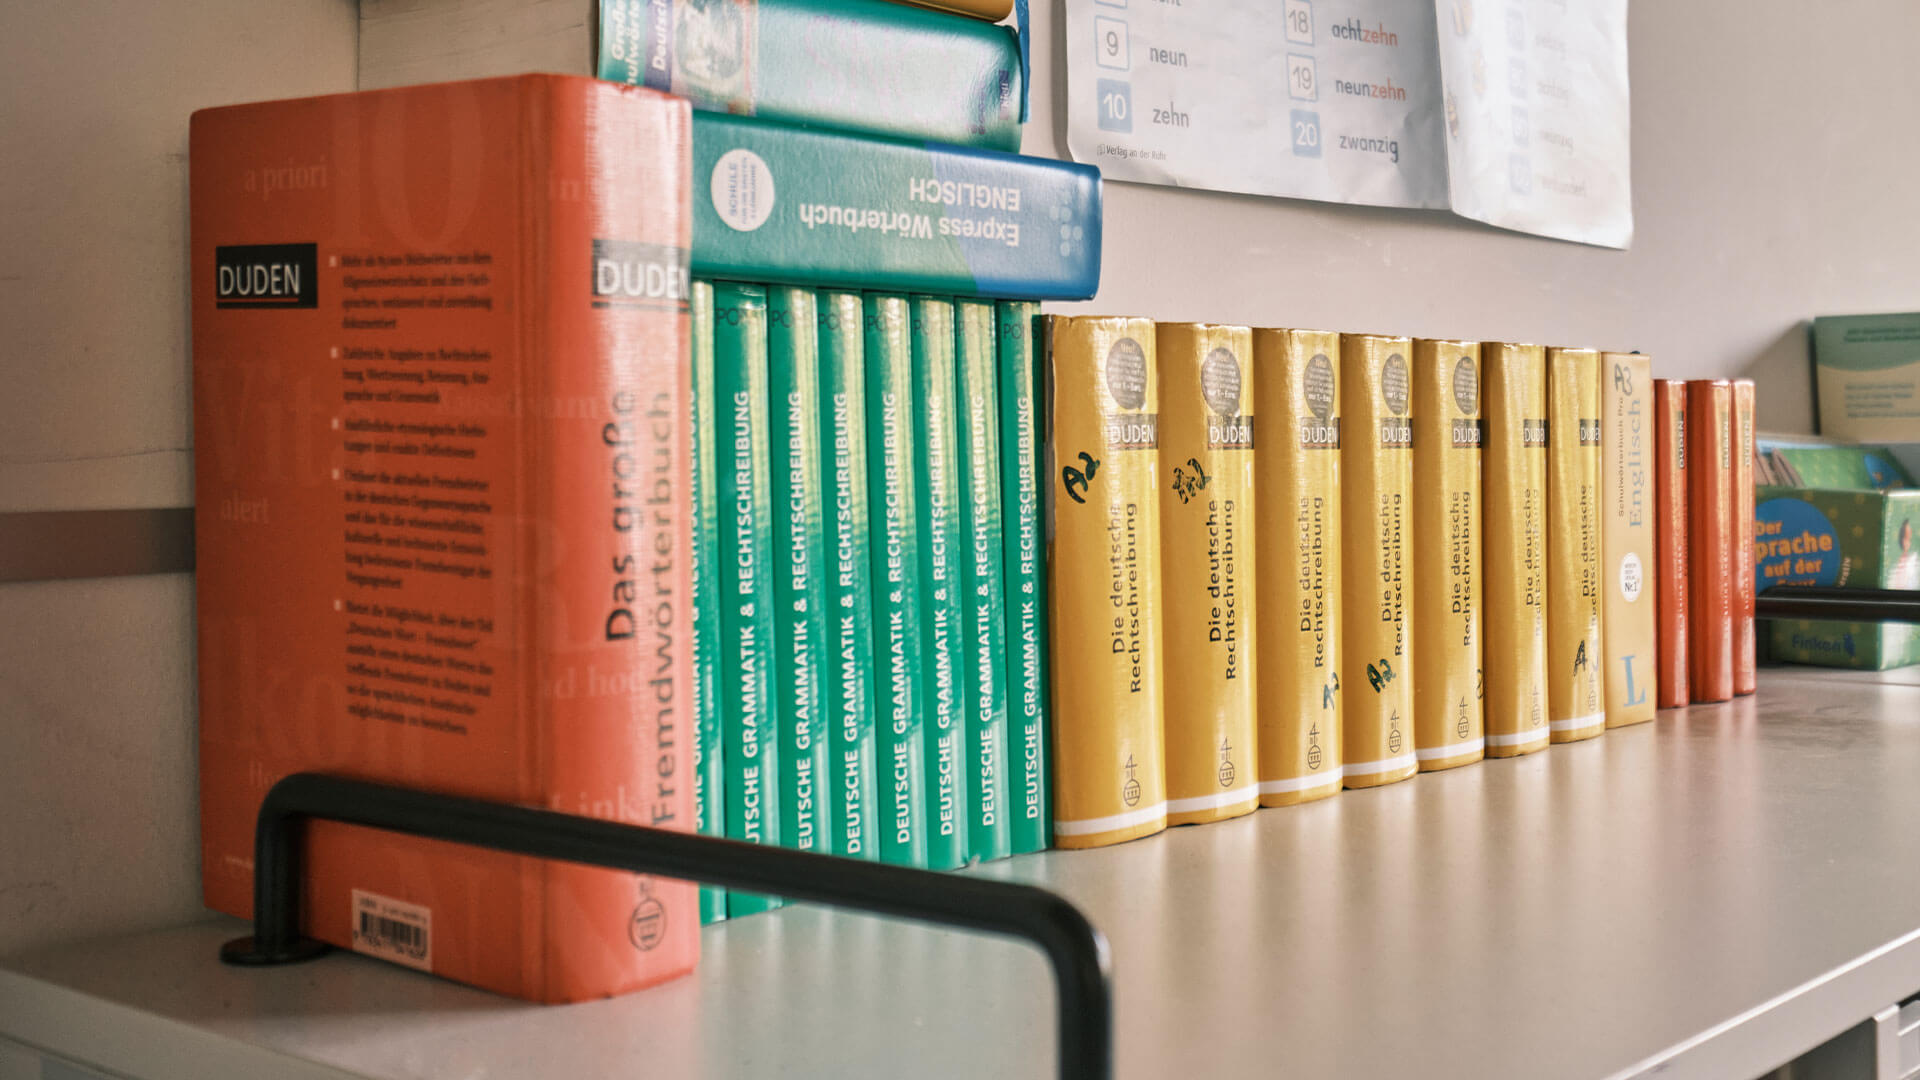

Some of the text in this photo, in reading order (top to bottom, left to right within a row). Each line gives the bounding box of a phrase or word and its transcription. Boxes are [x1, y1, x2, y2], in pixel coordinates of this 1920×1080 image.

[1106, 31, 1119, 57] 9
[1288, 8, 1309, 34] 18
[1331, 20, 1398, 47] achtzehn
[1150, 47, 1188, 67] neun
[1292, 65, 1312, 90] 19
[1103, 92, 1127, 120] 10
[1335, 76, 1406, 102] neunzehn
[1152, 101, 1190, 128] zehn
[1295, 122, 1318, 147] 20
[1339, 131, 1399, 162] zwanzig
[908, 177, 1020, 212] ENGLISCH
[800, 203, 1020, 247] Express Wörterbuch
[219, 262, 301, 296] DUDEN
[595, 261, 690, 300] DUDEN
[1614, 362, 1633, 397] A3
[1110, 425, 1154, 443] DUDEN
[1209, 425, 1250, 443] DUDEN
[1301, 426, 1337, 444] DUDEN
[1382, 426, 1412, 443] DUDEN
[1453, 427, 1480, 443] DUDEN
[1524, 427, 1545, 442] DUDE
[1677, 420, 1685, 469] DUDEN
[1062, 451, 1100, 503] A2
[1628, 399, 1644, 528] Englisch
[603, 391, 643, 642] Das große
[1755, 520, 1783, 537] Der
[1298, 495, 1311, 632] Die deutsche
[1380, 494, 1393, 622] Die deutsche
[1450, 491, 1462, 614] Die deutsche
[1523, 488, 1535, 607] Die deutsche
[1580, 484, 1591, 598] Die deutsche
[1755, 530, 1833, 564] prache
[1107, 502, 1126, 655] Die deutsche
[1205, 499, 1222, 643] Die deutsche
[1223, 499, 1237, 681] Rechtschreibung
[1313, 496, 1324, 668] Rechtschreibung
[1393, 493, 1403, 656] Rechtschreibung
[1462, 491, 1472, 647] Rechtschreibung
[1764, 558, 1823, 578] auf der
[646, 391, 676, 826] Fremdwörterbuch
[734, 391, 761, 845] UTSCHE GRAMMATIK & RECHTSCHREIBUNG
[788, 391, 814, 850] EUTSCHE GRAMMATIK & RECHTSCHREIBUNG
[883, 392, 911, 844] DEUTSCHE GRAMMATIK & RECHTSCHREIBUNG
[928, 394, 954, 836] DEUTSCHE GRAMMATIK & RECHTSCHREIBUNG
[970, 393, 995, 827] DEUTSCHE GRAMMATIK & RECHTSCHREIBUNG
[1017, 397, 1039, 819] DEUTSCHE GRAMMATIK & RECHTSCHREIBUNG
[1126, 503, 1142, 694] Rechtschreibung
[834, 392, 862, 855] DEUTSCHE GRAMMATIK & RECHTSCHREIBUNG
[1366, 658, 1397, 693] A2
[1620, 655, 1647, 707] L
